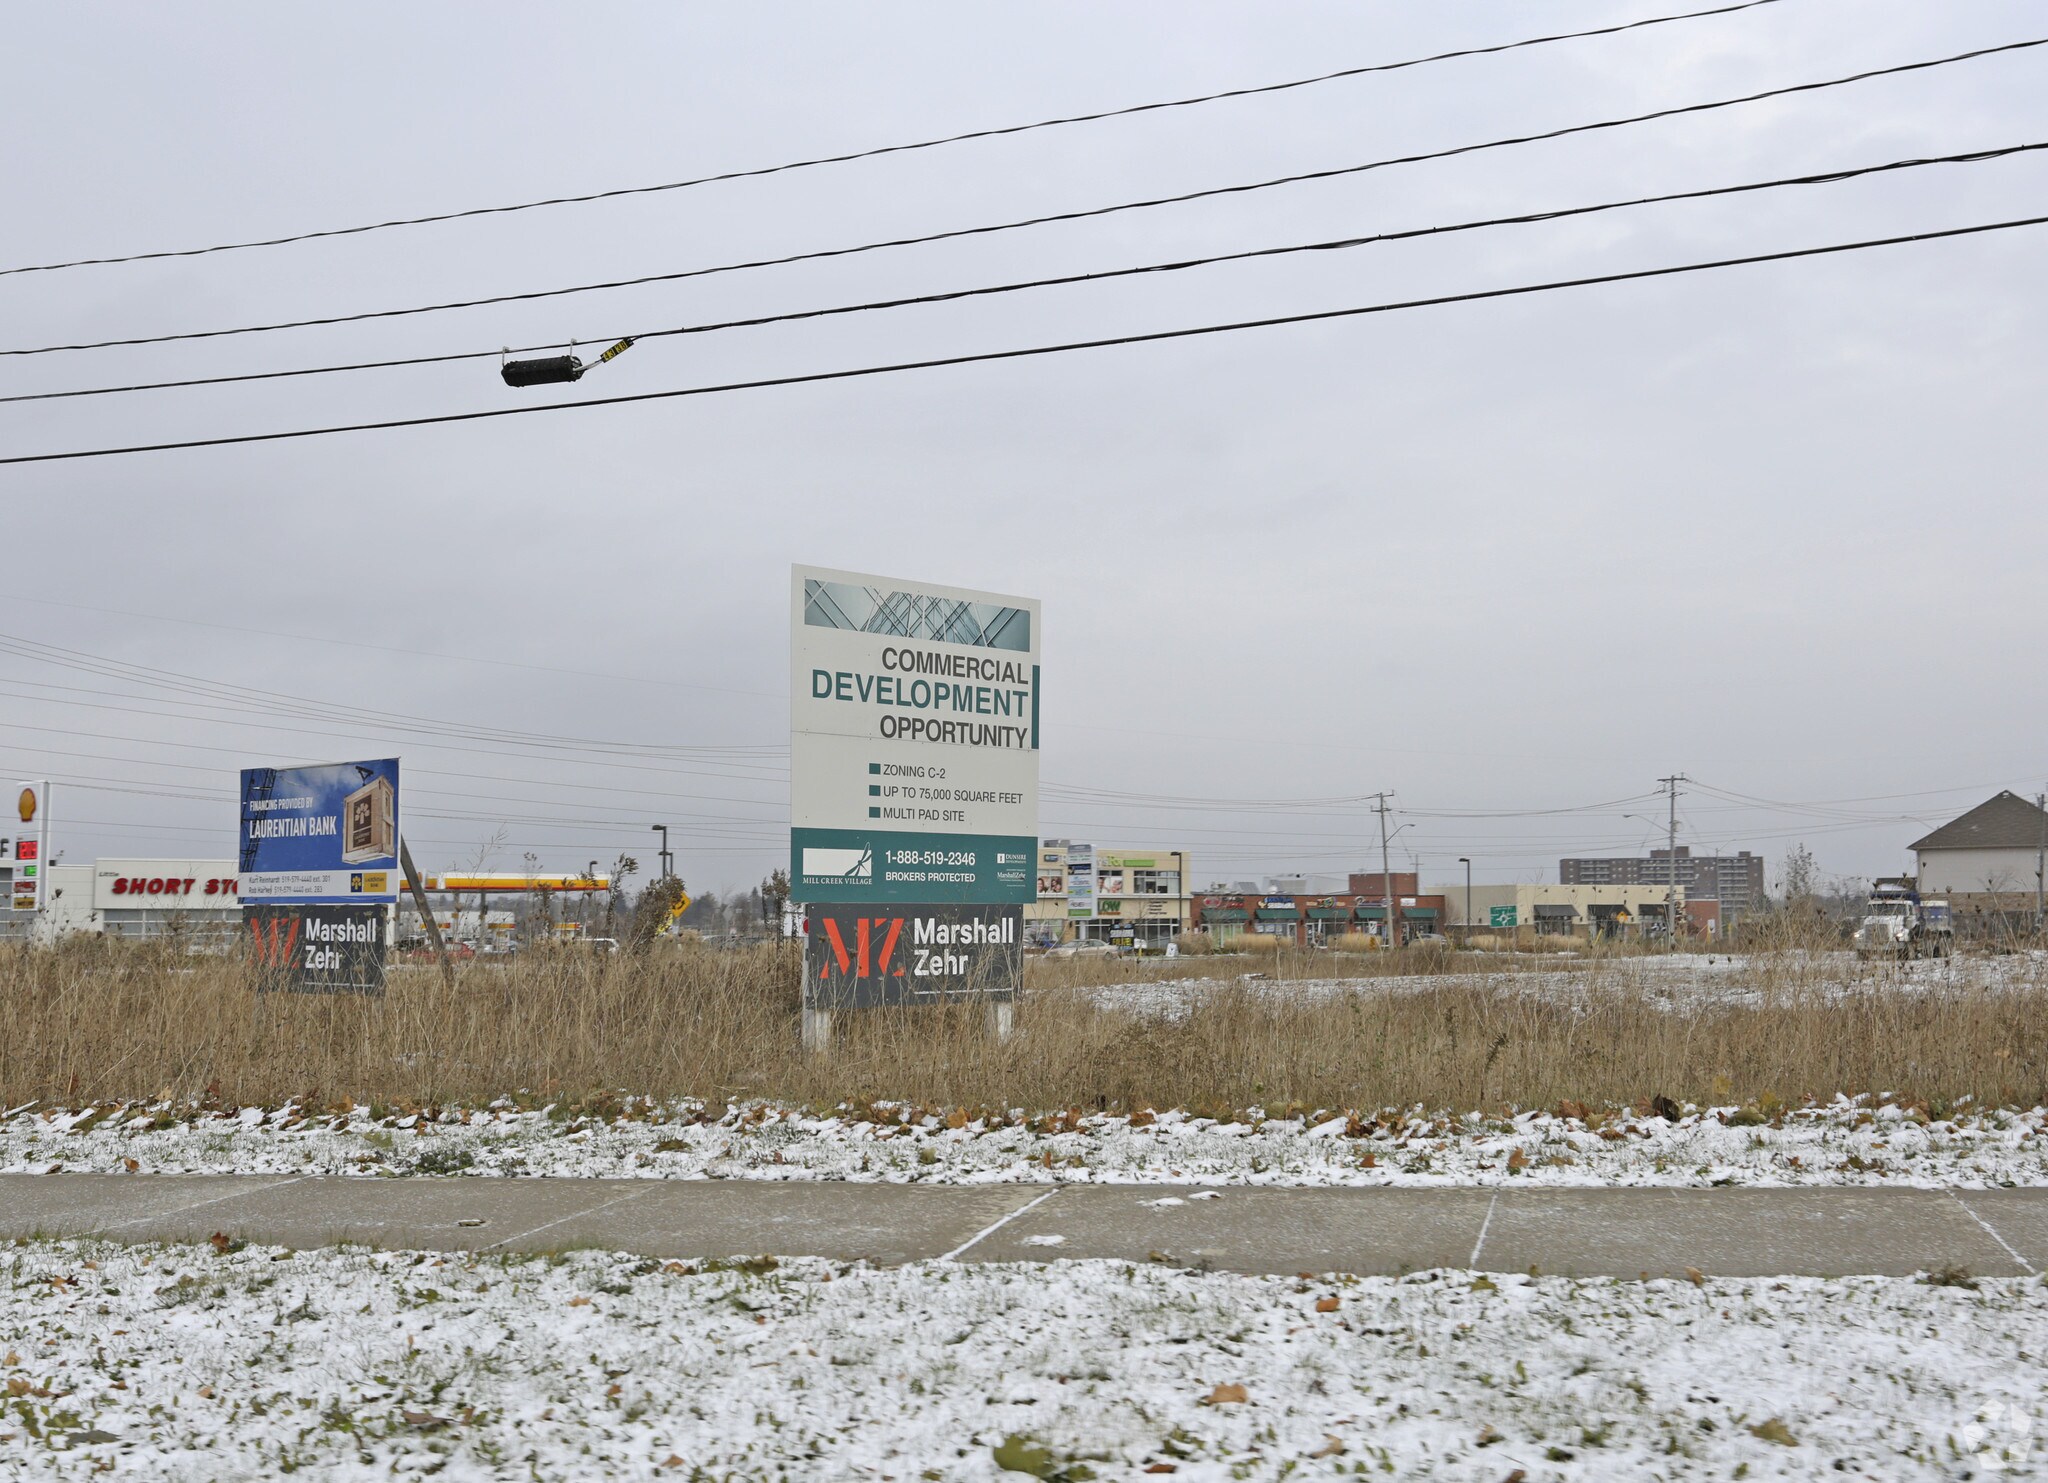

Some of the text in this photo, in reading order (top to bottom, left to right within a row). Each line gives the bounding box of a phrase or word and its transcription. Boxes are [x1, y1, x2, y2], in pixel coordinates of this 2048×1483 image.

[882, 647, 1029, 685] COMMERCIAL
[812, 669, 1029, 717] DEVELOPMENT
[880, 715, 1028, 749] OPPORTUNITY
[883, 764, 946, 779] ZONING C-2
[250, 796, 313, 812] FINANCING PROVIDED BY
[883, 786, 1023, 804] UP TO 75,000 SQUARE FEET
[883, 807, 965, 822] MULTI PAD SITE
[249, 815, 337, 839] LAURENTIAN BANK
[885, 850, 976, 866] 1-888-519-2346
[112, 877, 196, 895] SHORT
[820, 877, 843, 885] CREEK
[885, 871, 976, 882] BROKERS PROTECTED
[306, 917, 377, 942] Marshall
[914, 917, 1014, 945] Marshall
[305, 945, 343, 969] Zehr
[913, 948, 969, 976] Zehr
